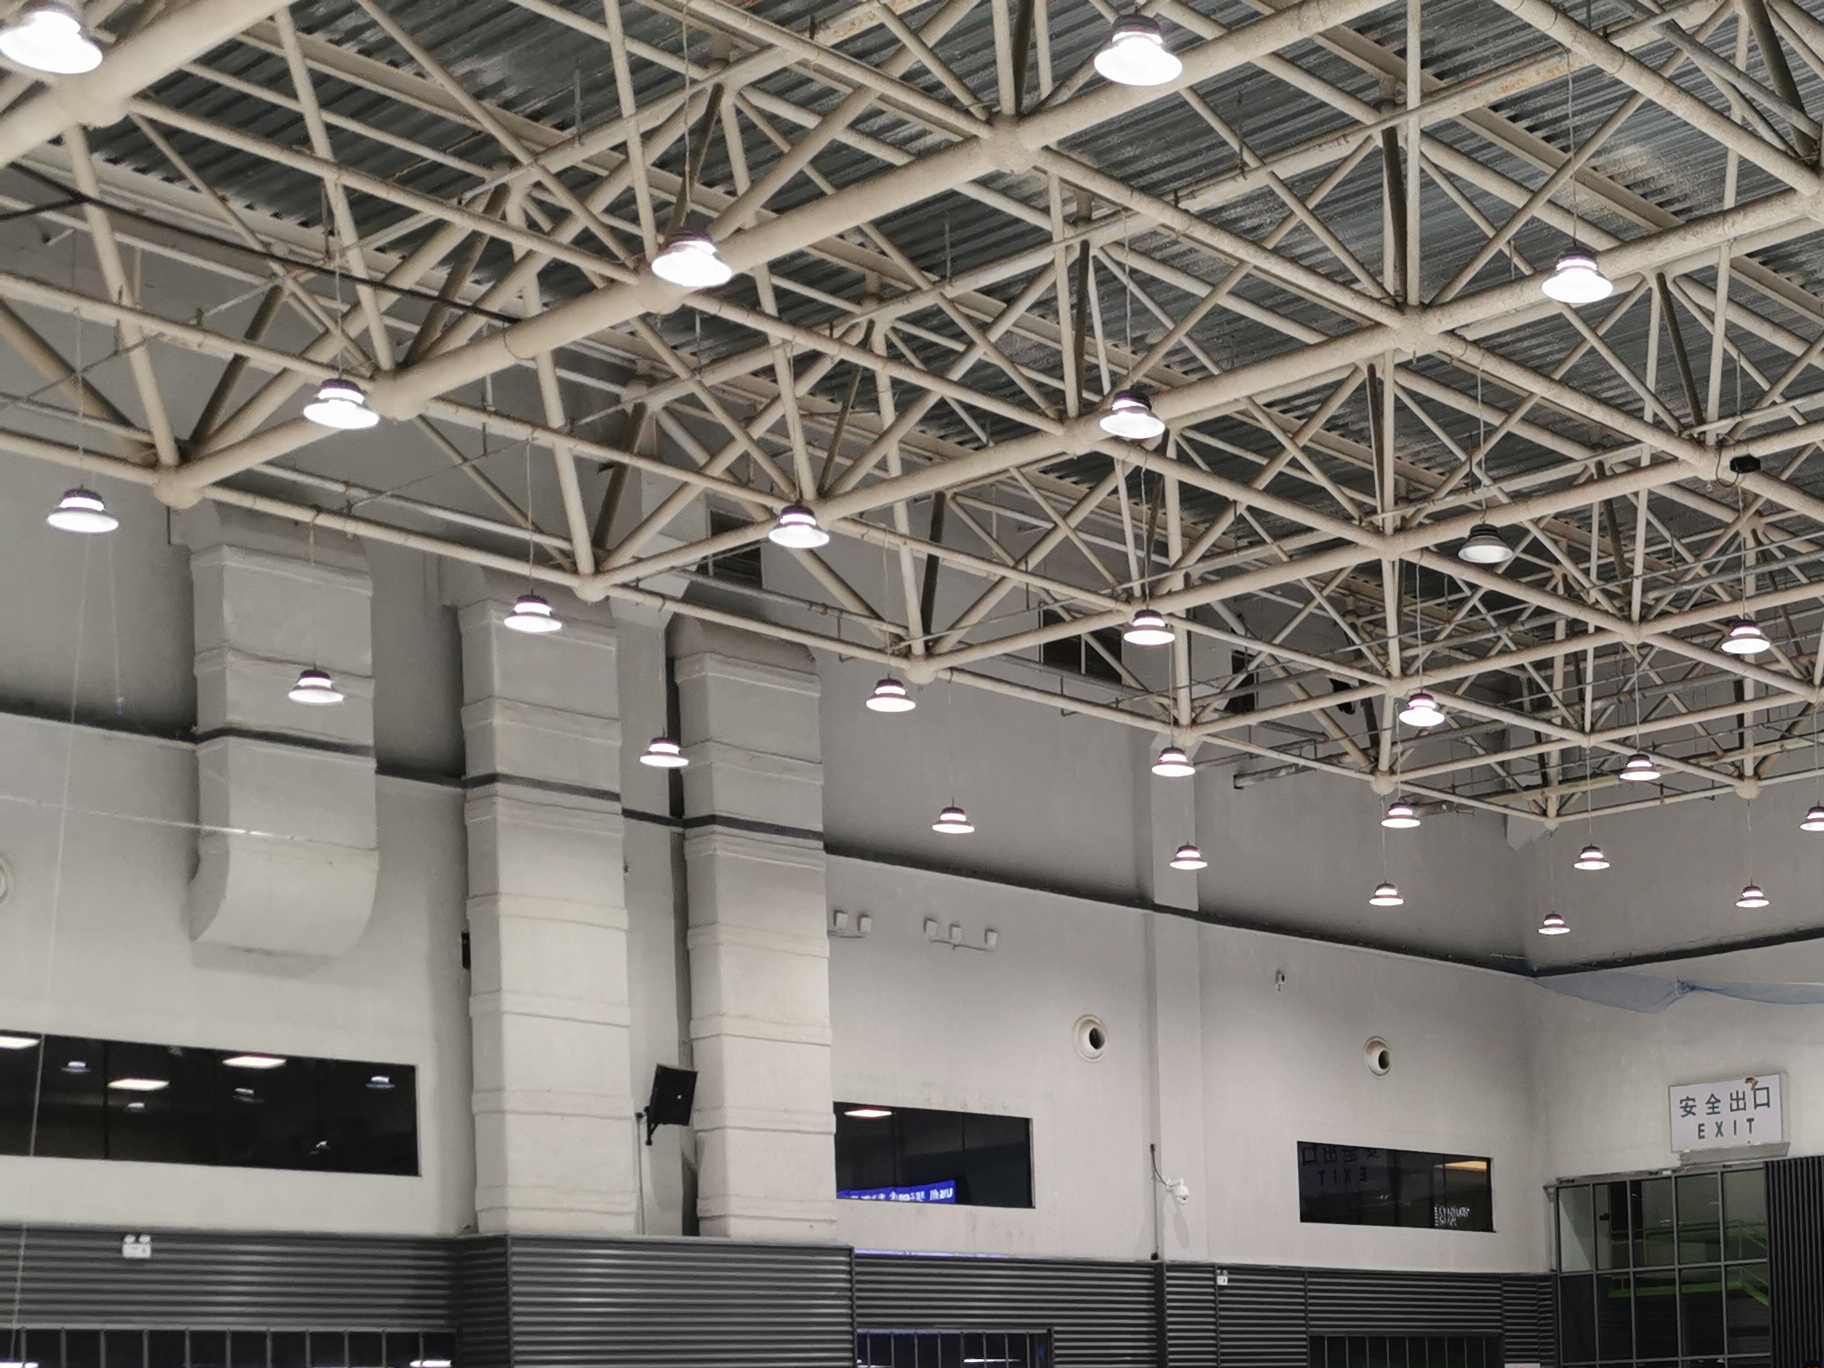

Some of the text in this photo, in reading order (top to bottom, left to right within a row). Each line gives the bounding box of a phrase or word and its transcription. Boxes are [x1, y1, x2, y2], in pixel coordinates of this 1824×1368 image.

[1679, 1086, 1770, 1118] 安全出口
[1698, 1118, 1754, 1139] EXIT
